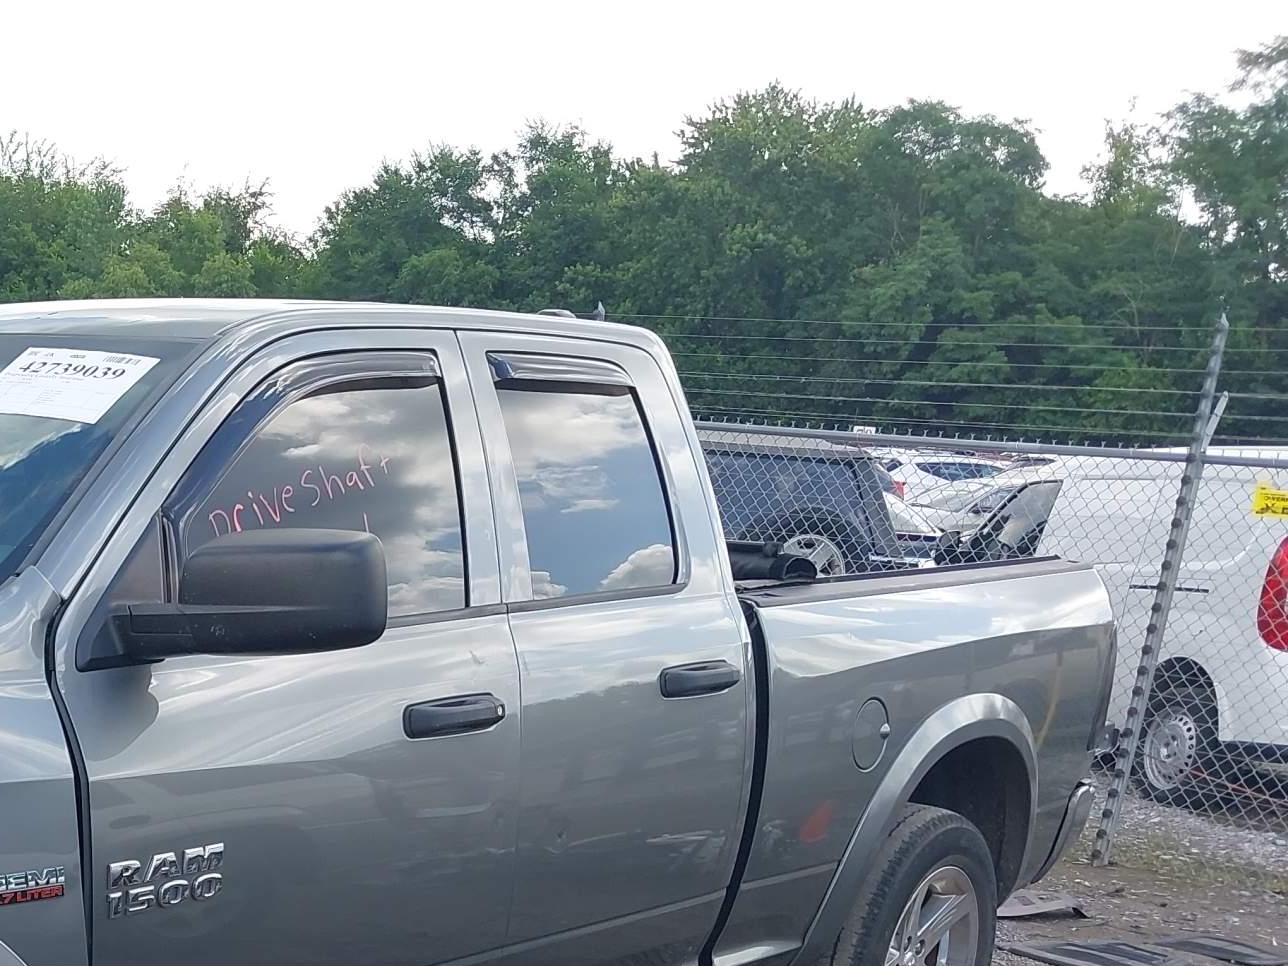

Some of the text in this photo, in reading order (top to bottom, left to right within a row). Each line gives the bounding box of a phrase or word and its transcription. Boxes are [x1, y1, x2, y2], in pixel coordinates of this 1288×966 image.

[19, 361, 127, 379] 42739039
[106, 842, 225, 890] RAM
[15, 886, 64, 903] LITER
[106, 872, 224, 920] 1500
